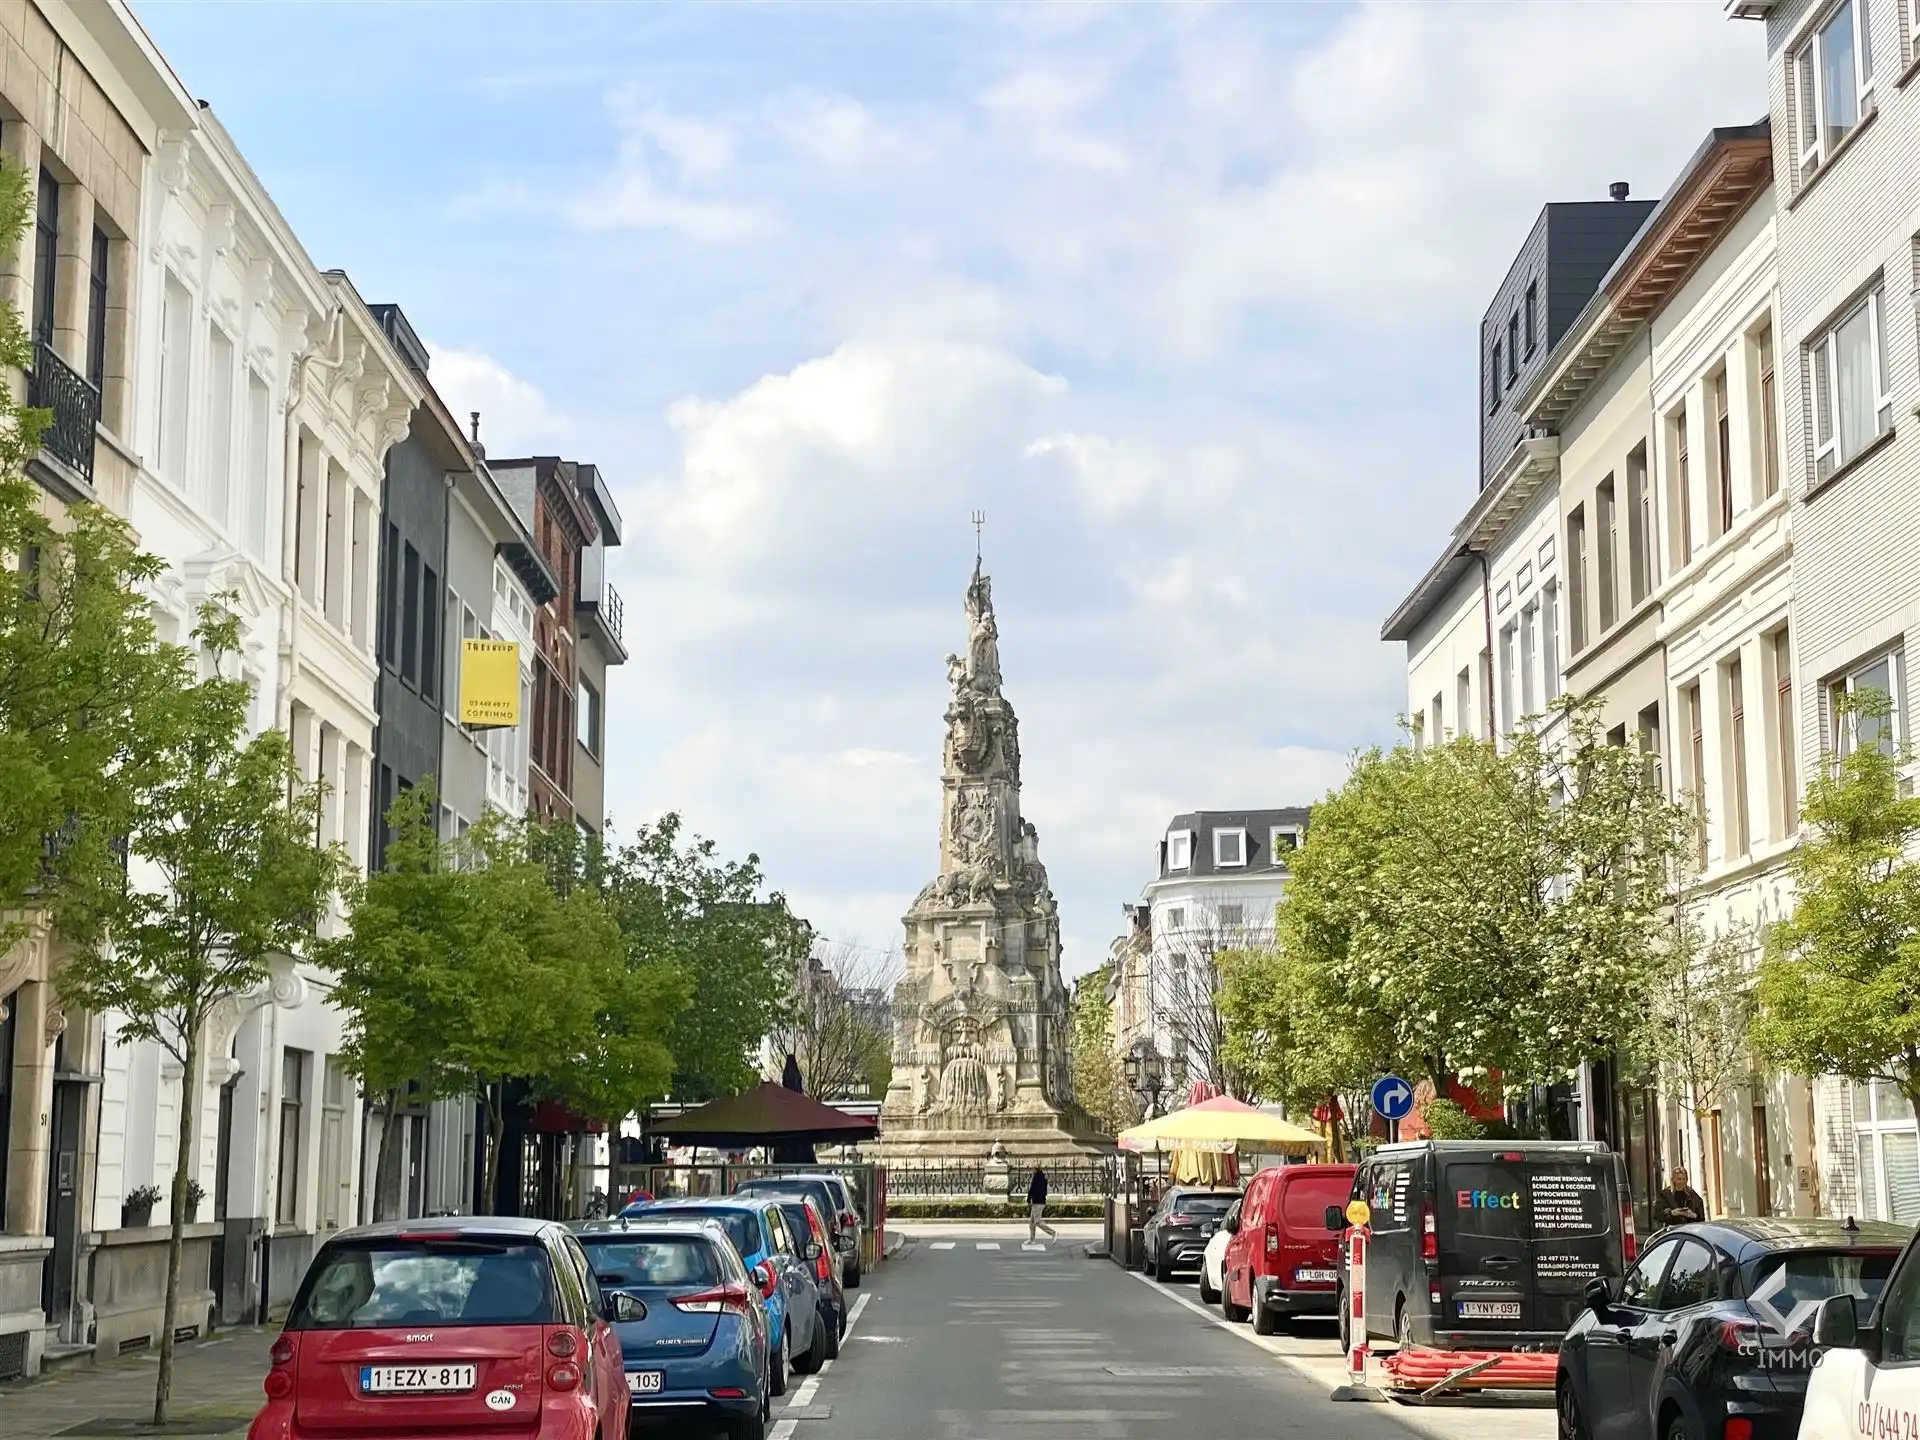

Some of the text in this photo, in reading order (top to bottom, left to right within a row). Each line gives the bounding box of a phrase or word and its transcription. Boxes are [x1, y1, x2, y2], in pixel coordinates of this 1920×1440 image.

[1457, 1190, 1520, 1210] Effect
[406, 1333, 434, 1343] smart
[490, 1395, 511, 1405] CAN
